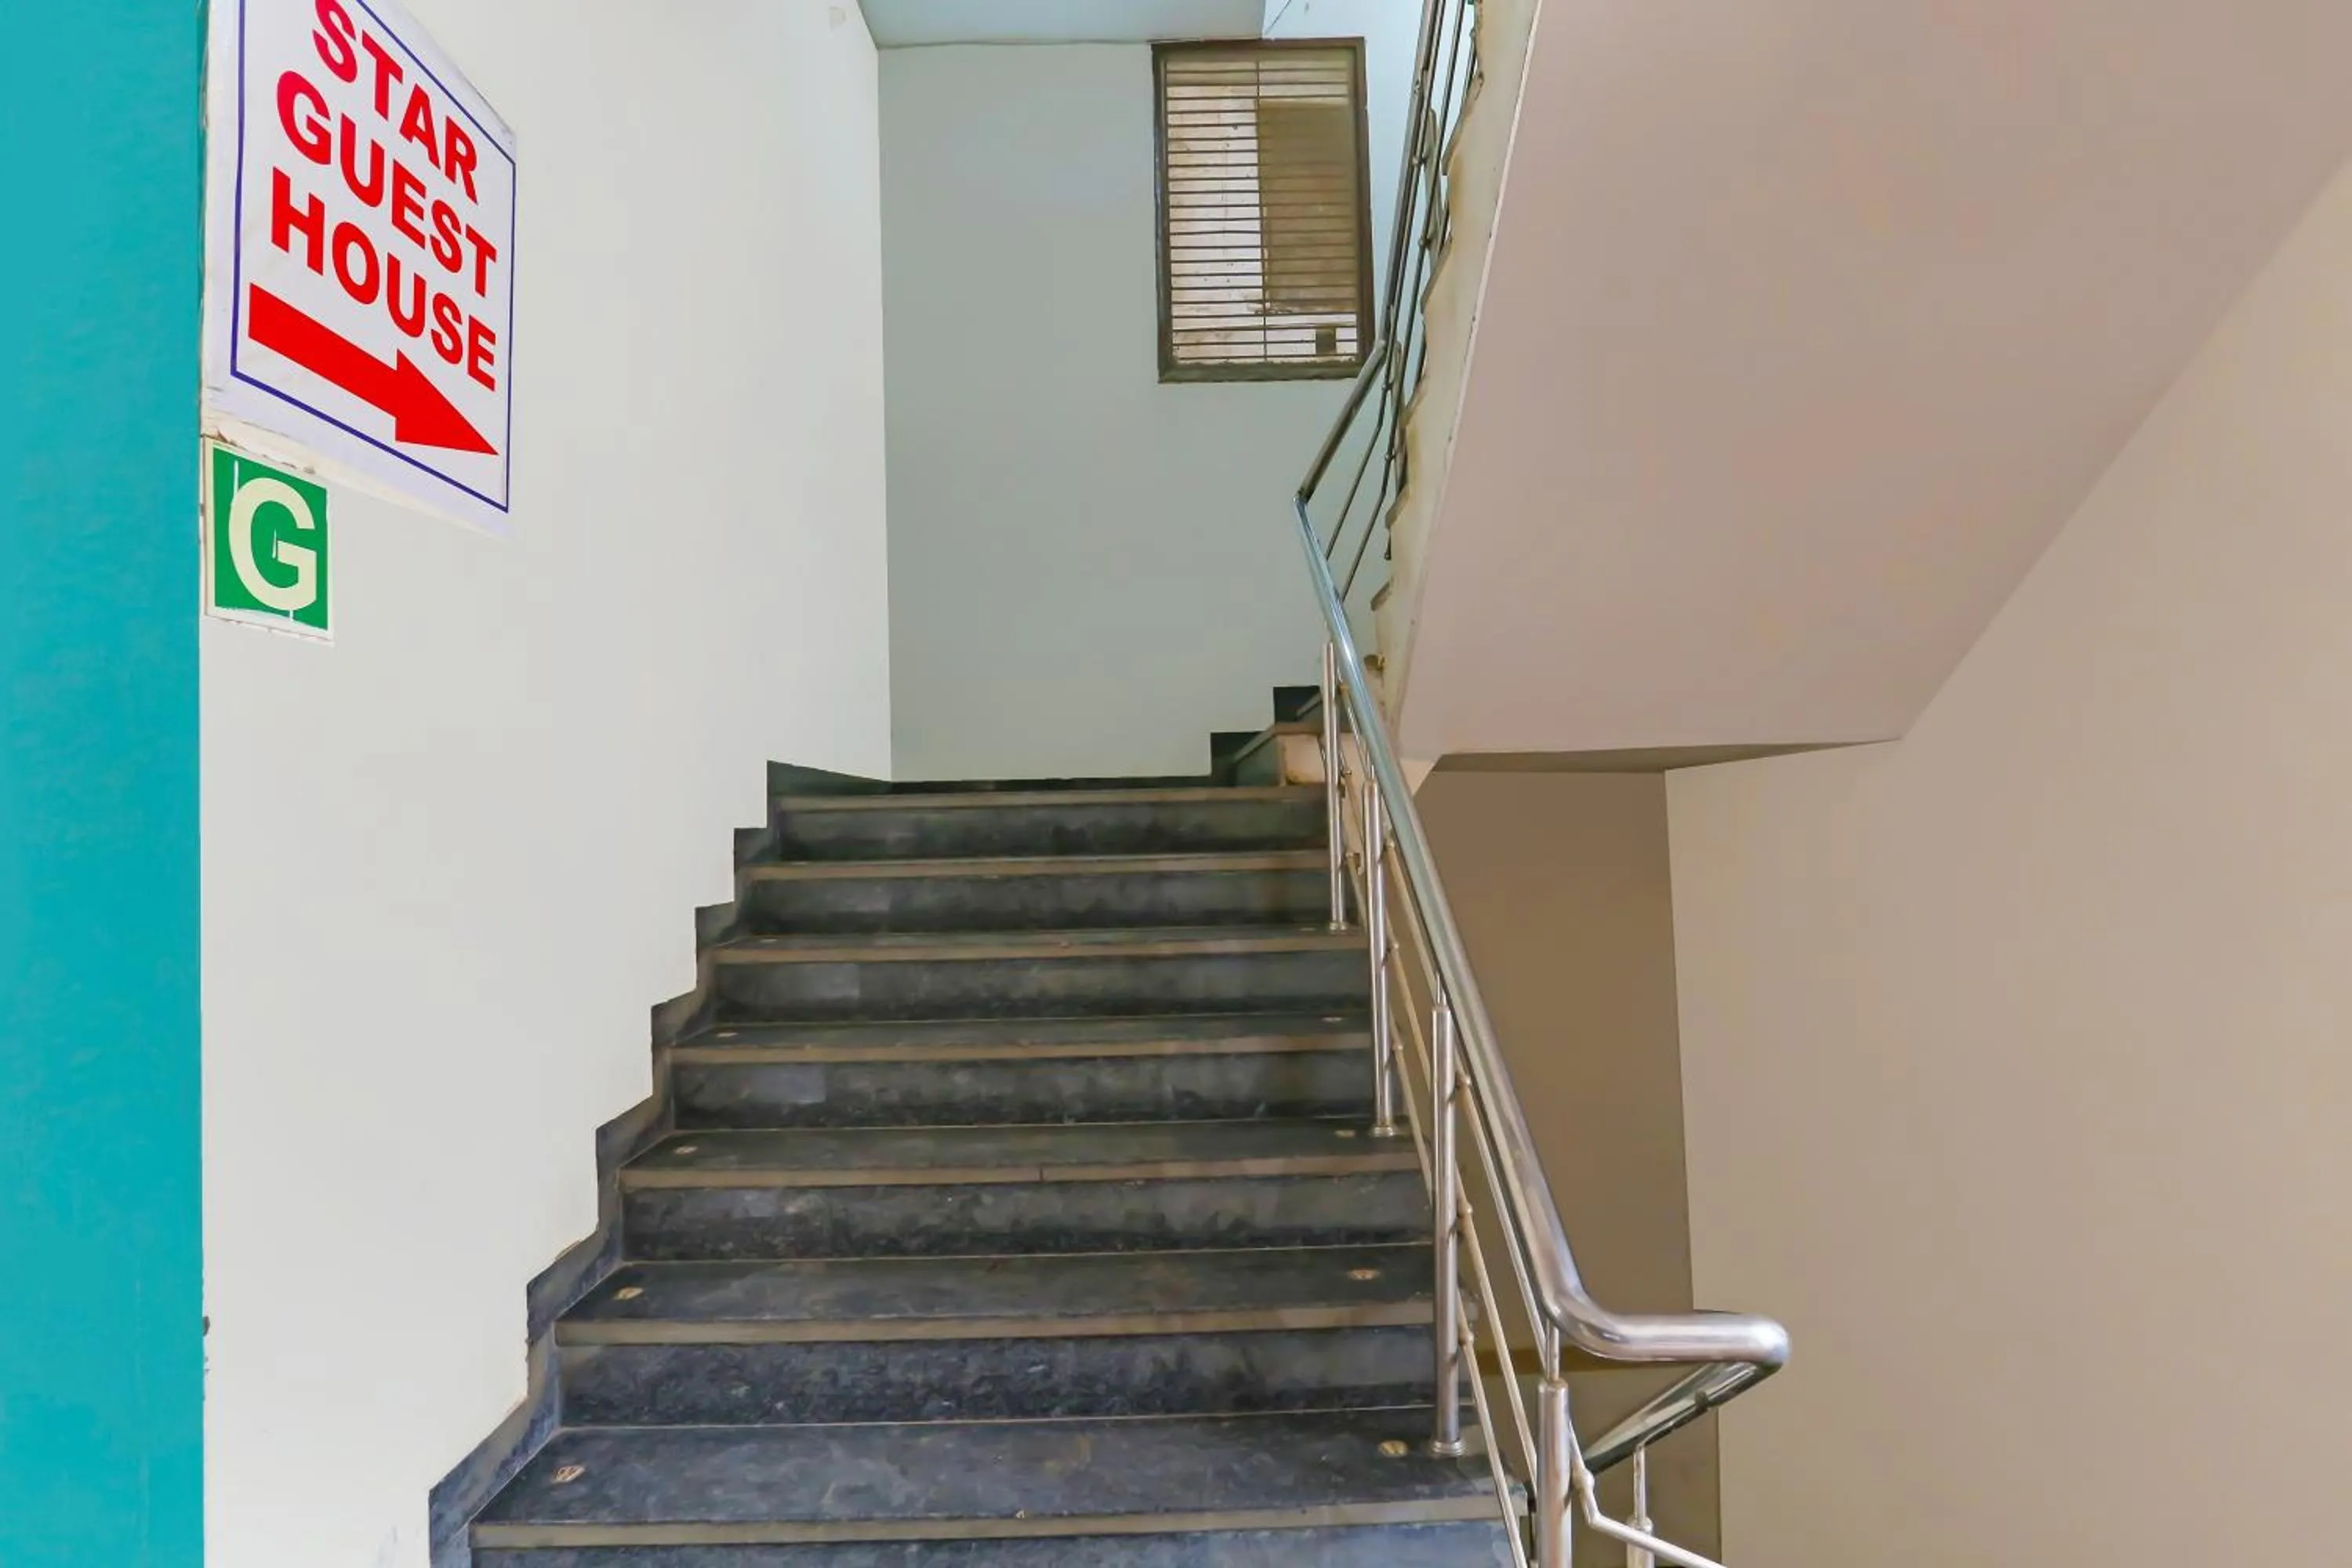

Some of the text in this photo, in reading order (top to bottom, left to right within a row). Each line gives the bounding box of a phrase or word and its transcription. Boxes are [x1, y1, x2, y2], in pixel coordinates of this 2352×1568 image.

[277, 71, 497, 297] GUEST
[312, 0, 478, 204] STAR
[271, 166, 496, 392] HOUSE
[228, 477, 317, 611] G
